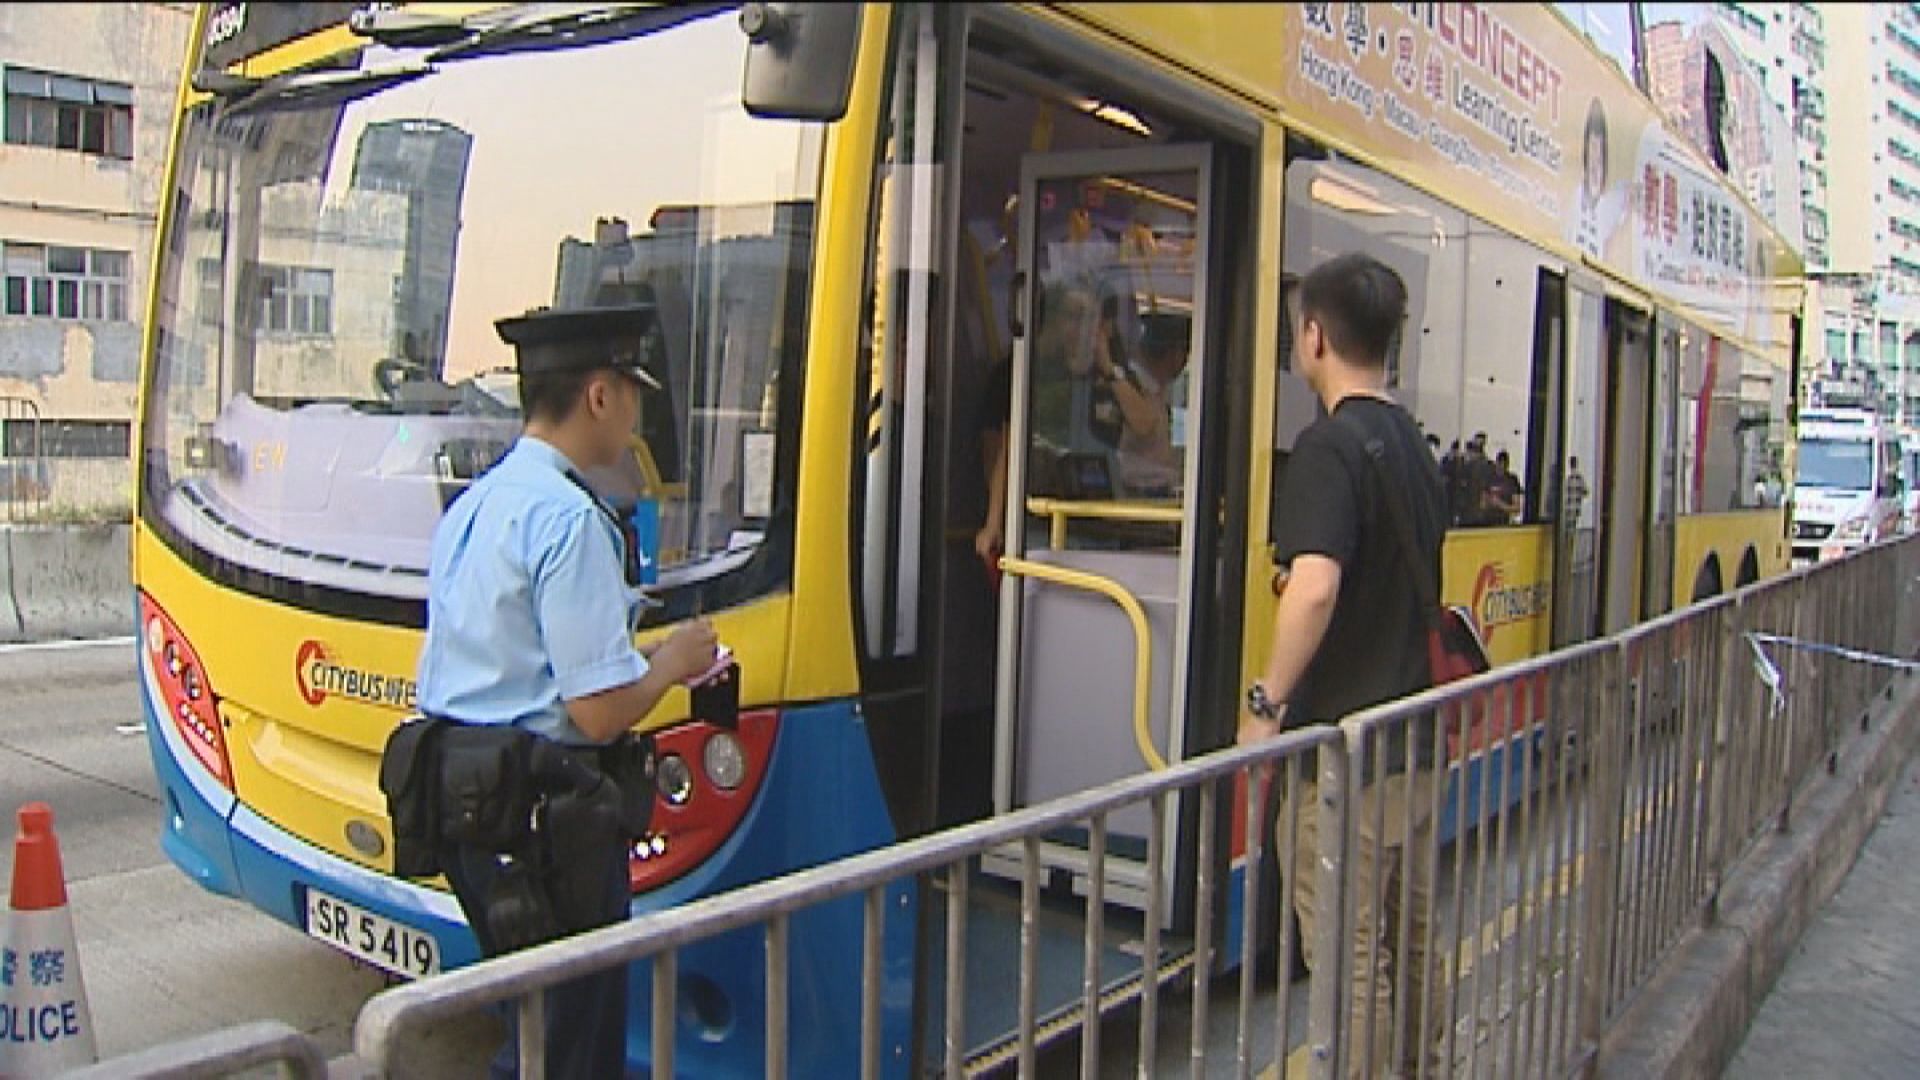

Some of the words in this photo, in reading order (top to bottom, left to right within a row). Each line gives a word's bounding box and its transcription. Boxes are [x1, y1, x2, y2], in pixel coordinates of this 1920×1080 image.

[1300, 44, 1336, 98] Hong
[1336, 65, 1373, 117] Kong
[1396, 2, 1561, 121] CONCEPT
[1453, 66, 1517, 153] Learning
[1519, 117, 1561, 169] Center
[312, 661, 383, 701] CITYBUS
[318, 897, 350, 945] SR
[360, 914, 433, 976] 5419
